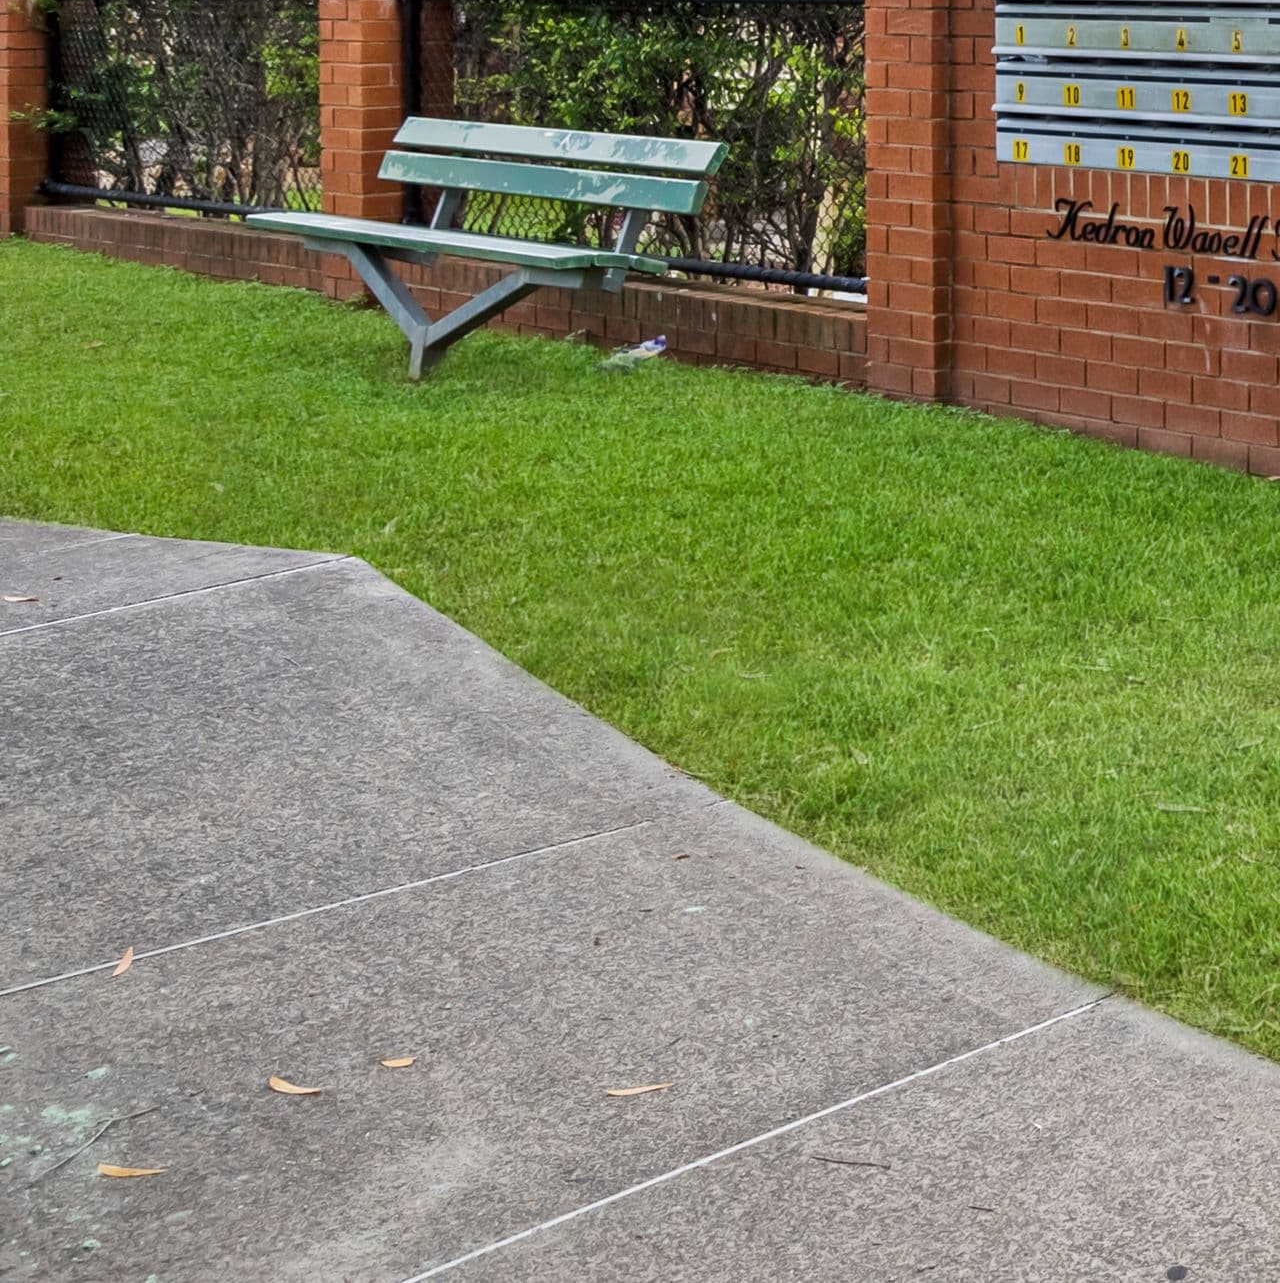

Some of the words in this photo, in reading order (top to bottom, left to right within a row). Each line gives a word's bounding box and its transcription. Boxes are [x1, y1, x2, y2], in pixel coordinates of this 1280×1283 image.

[1017, 25, 1024, 44] 1
[1068, 27, 1076, 46] 2
[1121, 28, 1129, 47] 3
[1177, 30, 1186, 48] 4
[1233, 32, 1241, 51] 5
[1017, 83, 1024, 99] 9
[1066, 86, 1079, 104] 10
[1120, 89, 1134, 106] 11
[1175, 91, 1189, 110] 12
[1231, 94, 1246, 113] 13
[1016, 142, 1028, 158] 17
[1067, 145, 1080, 163] 18
[1120, 149, 1134, 167] 19
[1174, 153, 1189, 171] 20
[1232, 157, 1247, 175] 21
[1046, 198, 1155, 249] Kedron
[1164, 266, 1195, 303] 12
[1228, 274, 1278, 316] 20
